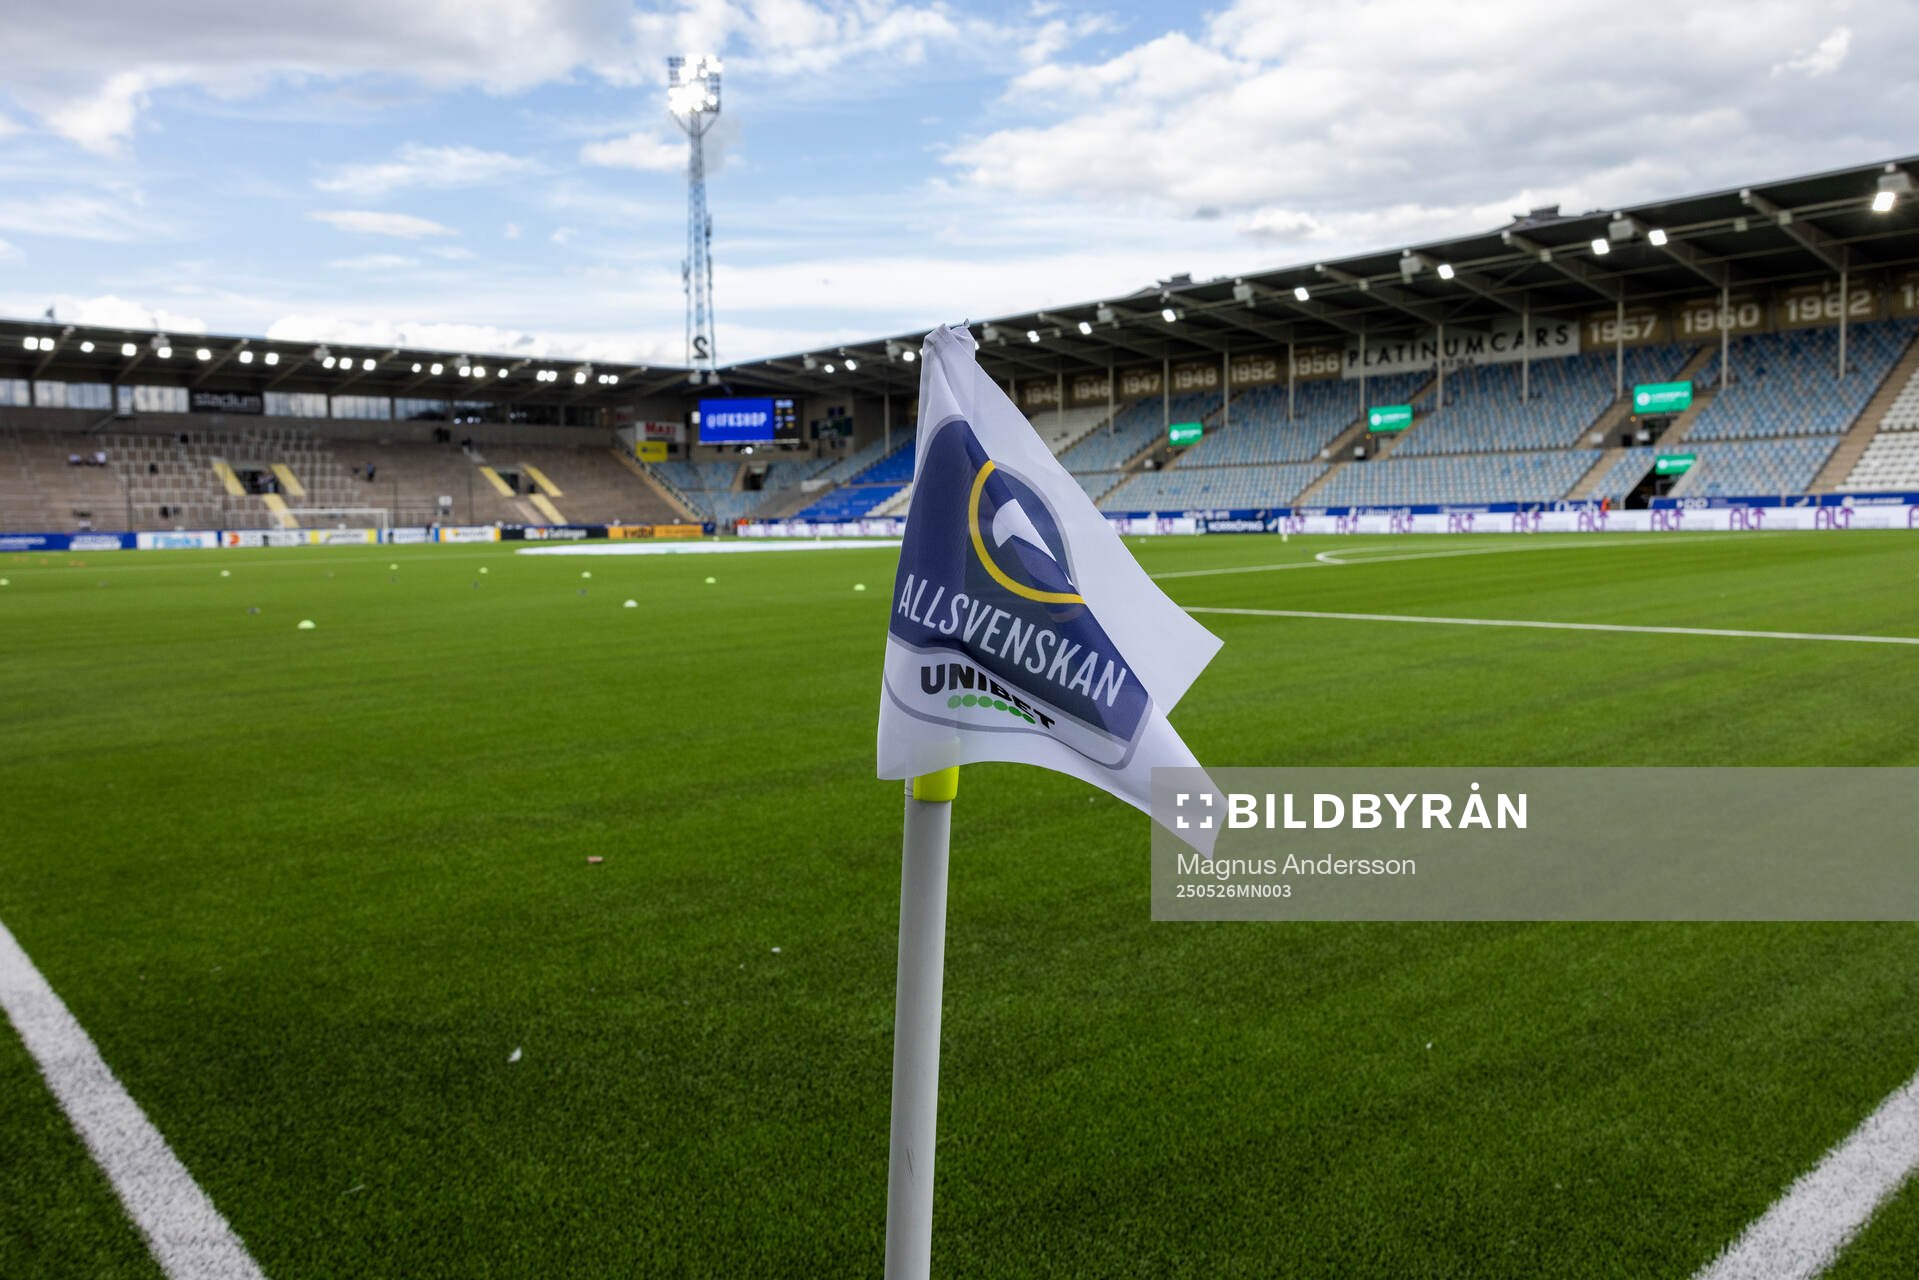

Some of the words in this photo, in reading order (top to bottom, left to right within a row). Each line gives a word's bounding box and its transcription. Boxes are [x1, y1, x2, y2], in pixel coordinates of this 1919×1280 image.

[1682, 303, 1761, 333] 1960
[1786, 289, 1872, 322] 1962
[1590, 315, 1657, 344] 1957
[1348, 325, 1569, 367] PLATINUMCARS
[1123, 375, 1161, 395] 1947
[1174, 368, 1217, 390] 1948
[1231, 362, 1277, 382] 1952
[898, 574, 1127, 708] ALLSVENSKAN
[920, 663, 1056, 730] UNIBET
